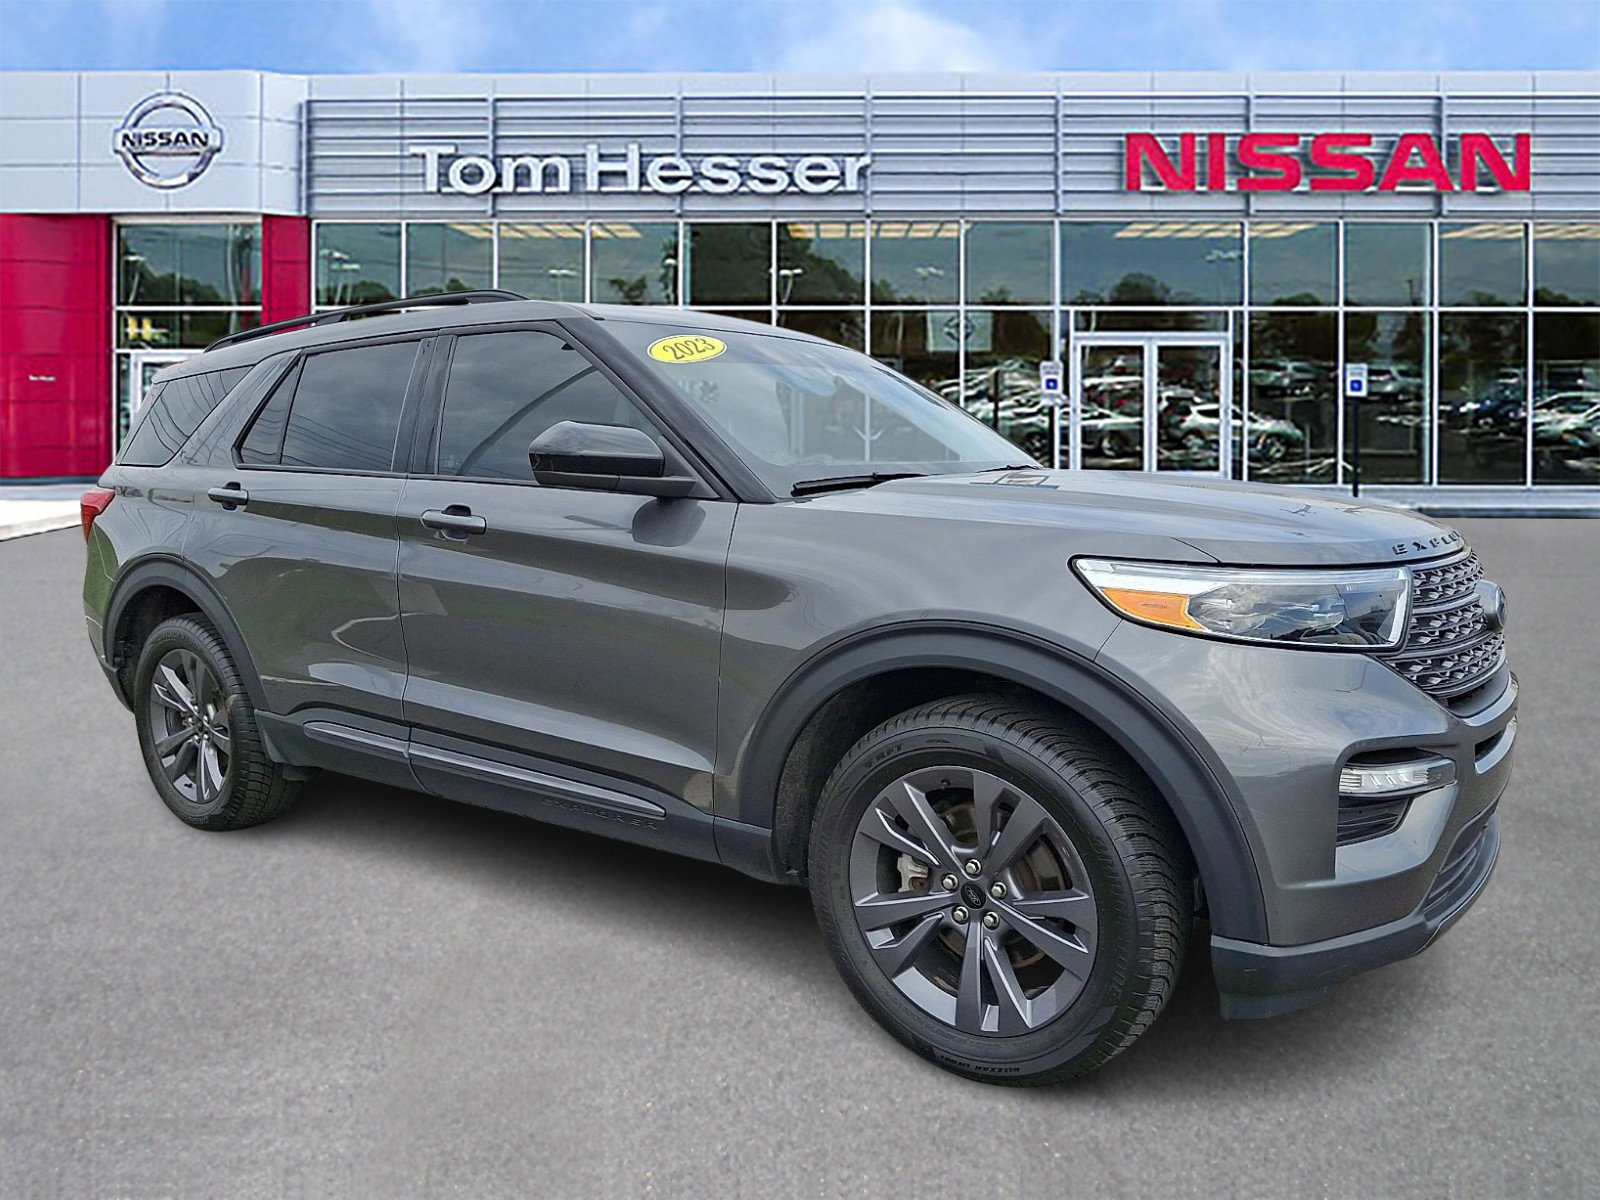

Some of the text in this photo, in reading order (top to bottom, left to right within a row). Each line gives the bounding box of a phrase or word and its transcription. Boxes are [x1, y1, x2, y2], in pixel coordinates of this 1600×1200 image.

[121, 131, 209, 147] NISSAN
[409, 143, 871, 194] Tom Hesser
[1125, 132, 1531, 191] NISSAN
[662, 338, 716, 360] 2023
